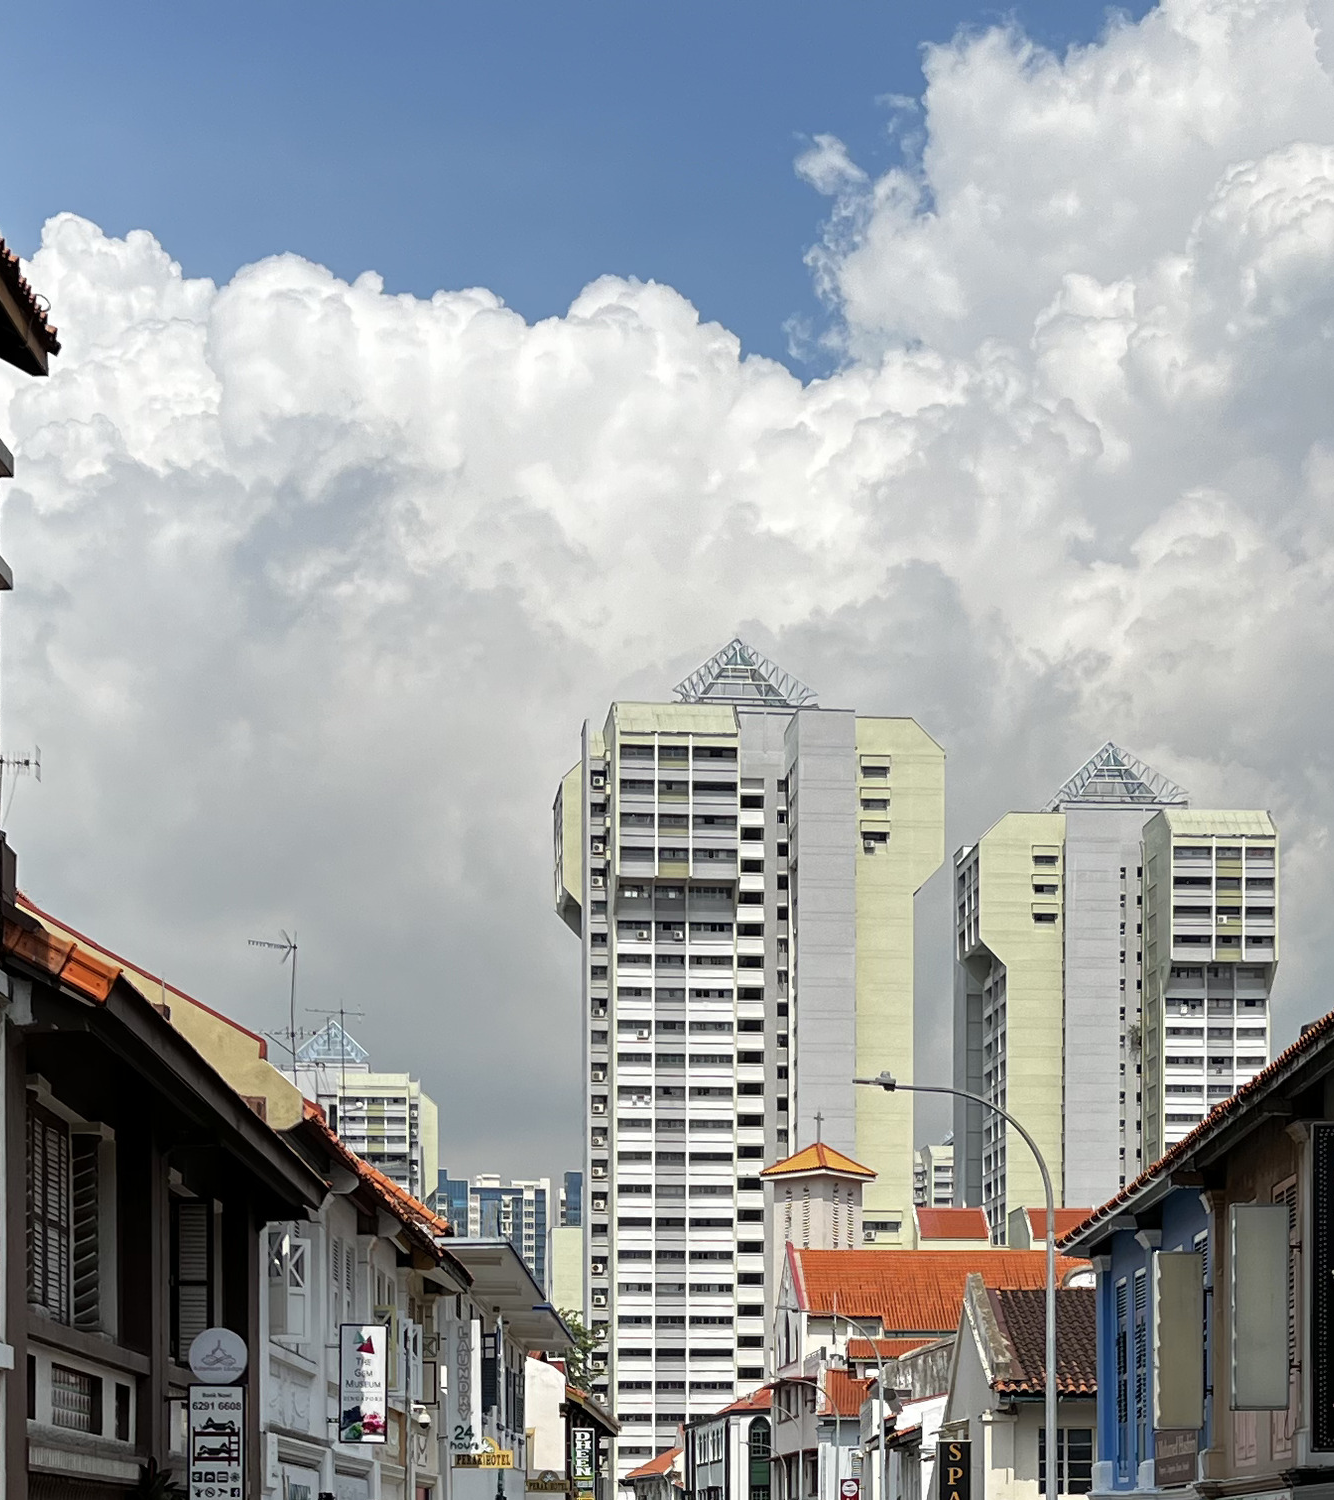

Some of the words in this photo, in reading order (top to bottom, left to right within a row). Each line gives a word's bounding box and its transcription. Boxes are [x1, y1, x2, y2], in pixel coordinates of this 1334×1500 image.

[354, 1369, 373, 1378] GEM
[457, 1326, 471, 1421] LAUNDRY
[345, 1379, 381, 1388] MUSEUM
[192, 1402, 214, 1411] 6291
[218, 1402, 241, 1411] 6608
[454, 1425, 474, 1440] 24
[456, 1454, 483, 1466] PERAK
[485, 1453, 511, 1466] HOTEL
[575, 1432, 592, 1476] DHEEN
[528, 1482, 548, 1491] PERAK
